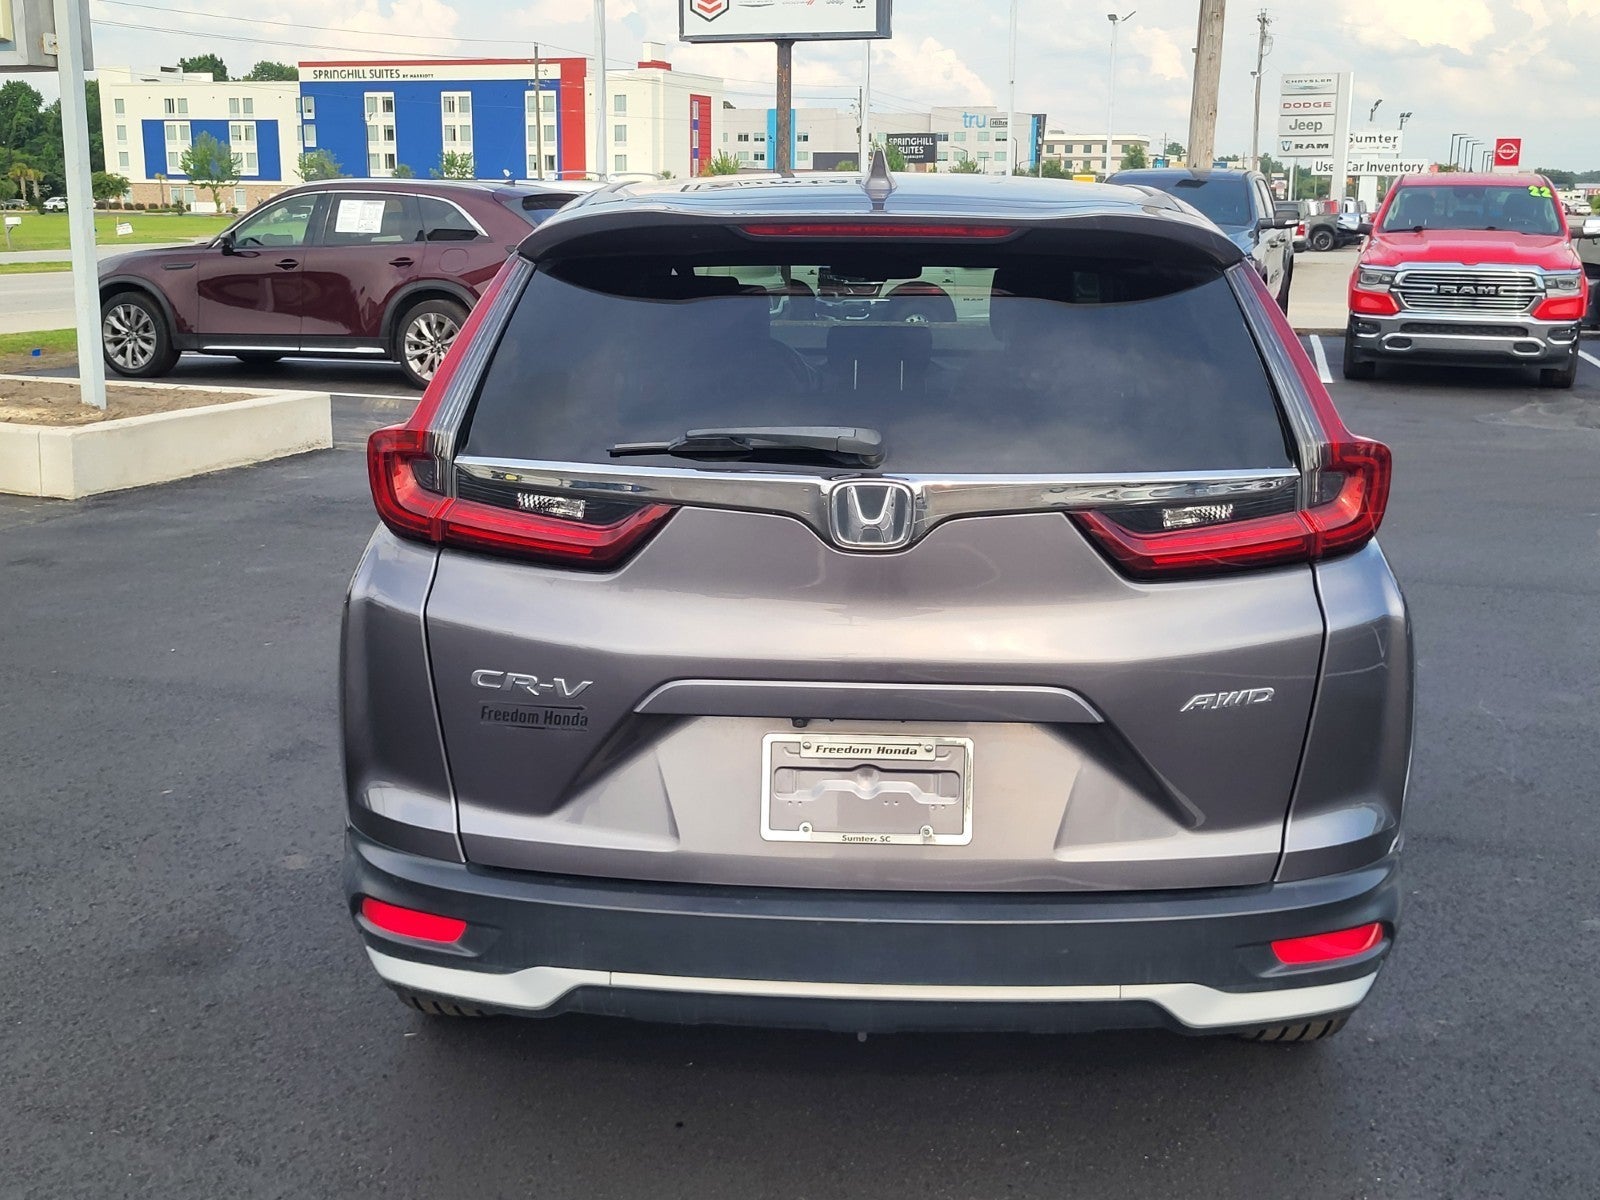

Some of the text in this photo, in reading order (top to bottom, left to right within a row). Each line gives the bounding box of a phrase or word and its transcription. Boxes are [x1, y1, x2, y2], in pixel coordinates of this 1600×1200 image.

[313, 69, 367, 79] SPRINGHILL
[369, 68, 401, 79] SUITES
[1282, 101, 1332, 109] DODGE
[962, 111, 987, 129] tru
[1289, 119, 1323, 132] Jeep
[888, 137, 934, 146] SPRINGHILL
[1294, 142, 1329, 150] RAM
[898, 146, 924, 155] SUITES
[1315, 160, 1334, 172] Use
[1366, 160, 1424, 174] Inventory
[1527, 184, 1553, 198] 22
[1439, 285, 1497, 295] RAM
[470, 668, 594, 700] CR-V
[1180, 687, 1275, 712] AWD
[480, 705, 589, 727] Freedom Honda
[815, 744, 918, 756] Freedom Honda
[879, 835, 891, 843] SC
